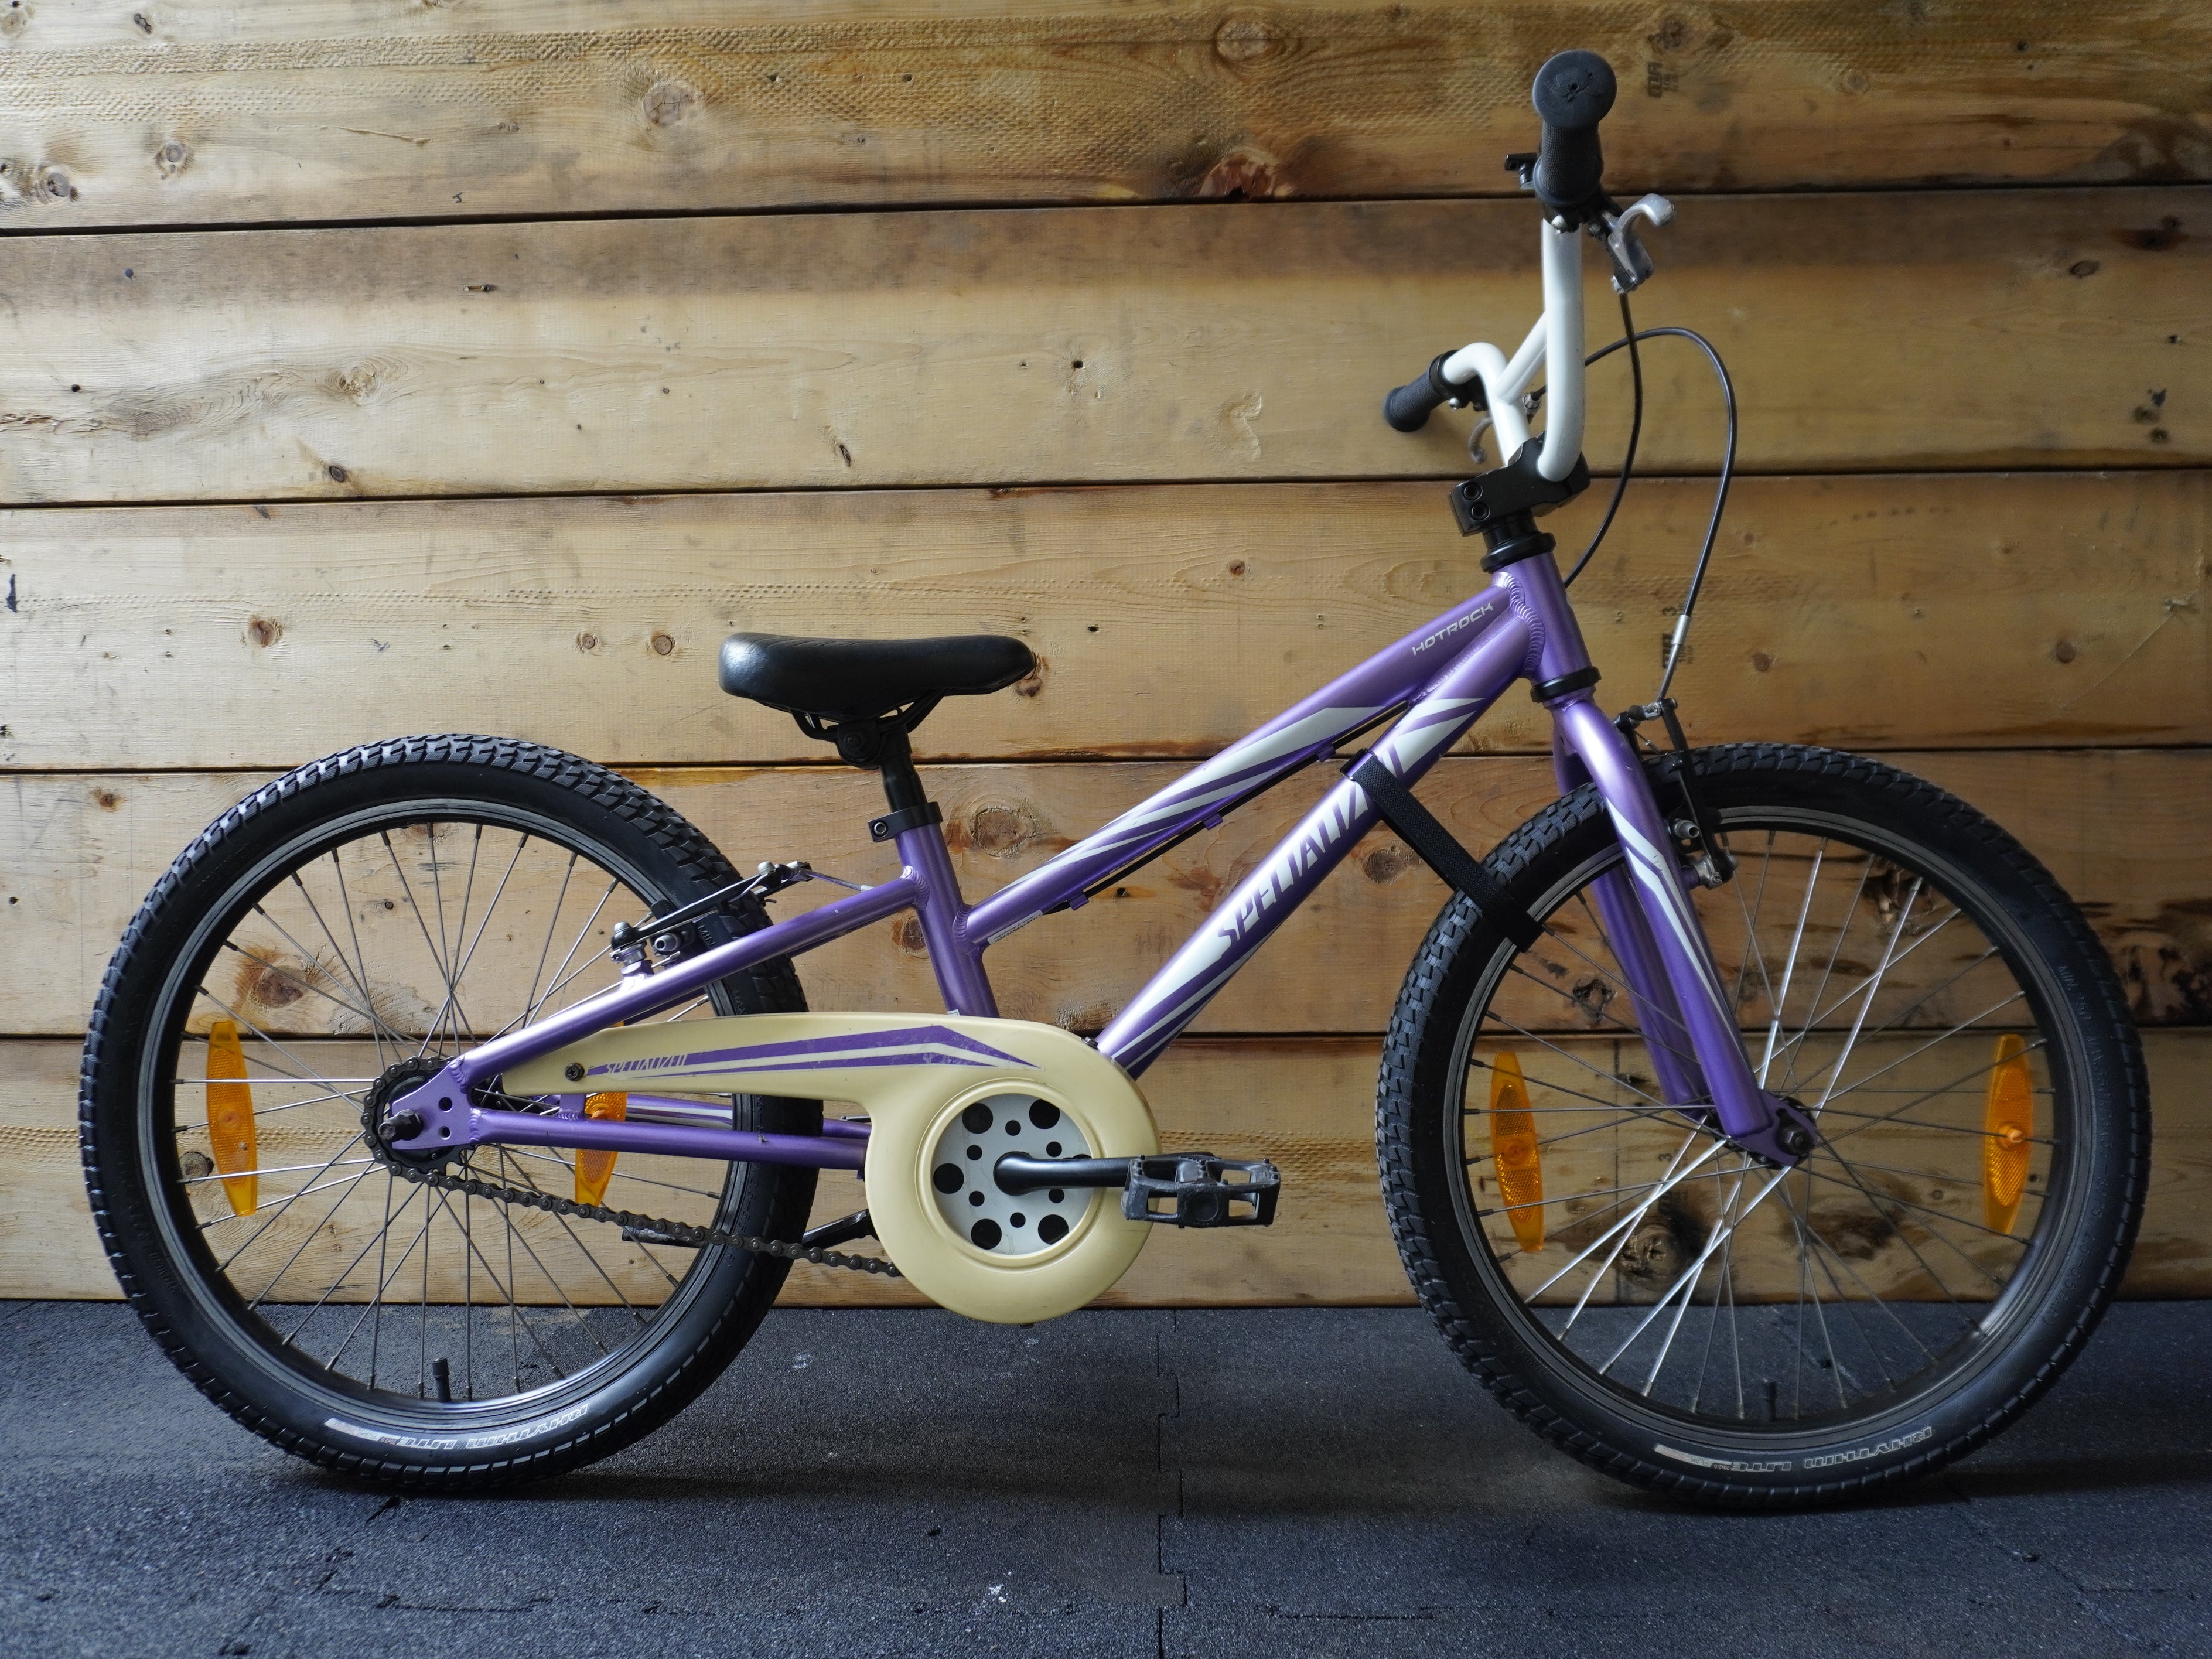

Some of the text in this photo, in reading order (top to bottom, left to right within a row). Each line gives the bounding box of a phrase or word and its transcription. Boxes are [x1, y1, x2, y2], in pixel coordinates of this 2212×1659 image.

[1412, 602, 1494, 656] HOTROCK
[606, 1054, 688, 1074] SPECIALIZED
[466, 1404, 589, 1449] RHYTHM
[396, 1436, 457, 1450] LITE
[1804, 1426, 1933, 1469] RHYTHM
[1730, 1461, 1793, 1472] LITE
